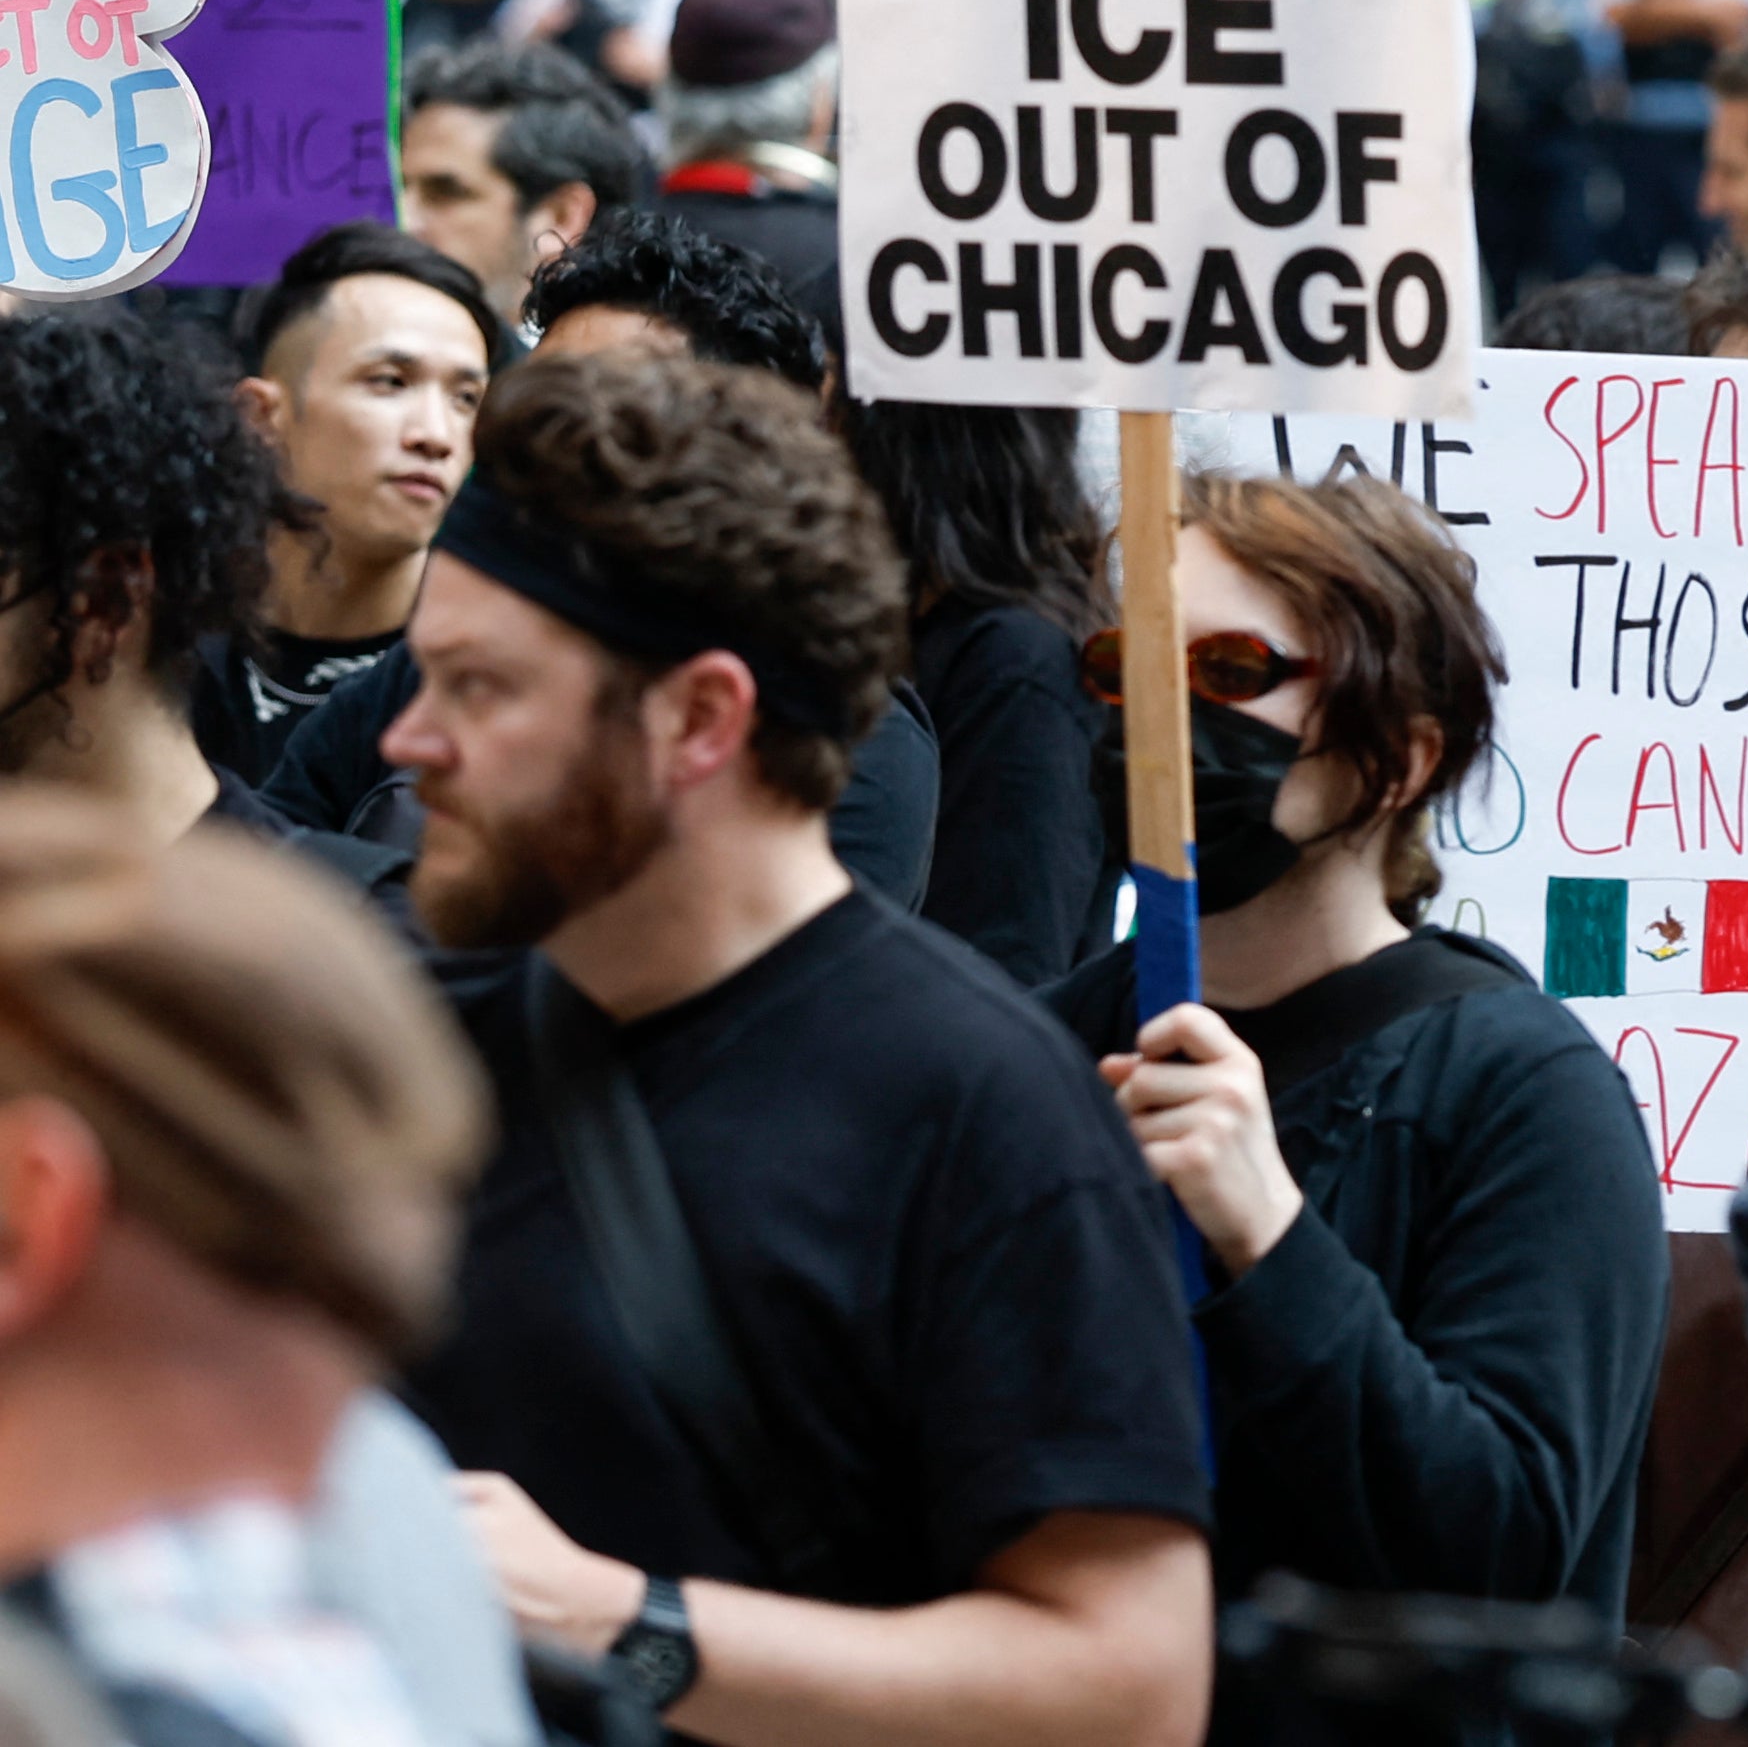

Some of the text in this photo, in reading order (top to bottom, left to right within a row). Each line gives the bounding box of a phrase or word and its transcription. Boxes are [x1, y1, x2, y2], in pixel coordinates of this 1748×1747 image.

[0, 70, 190, 282] GE
[916, 101, 1403, 229] OUT OF
[866, 237, 1449, 373] CHICAGO
